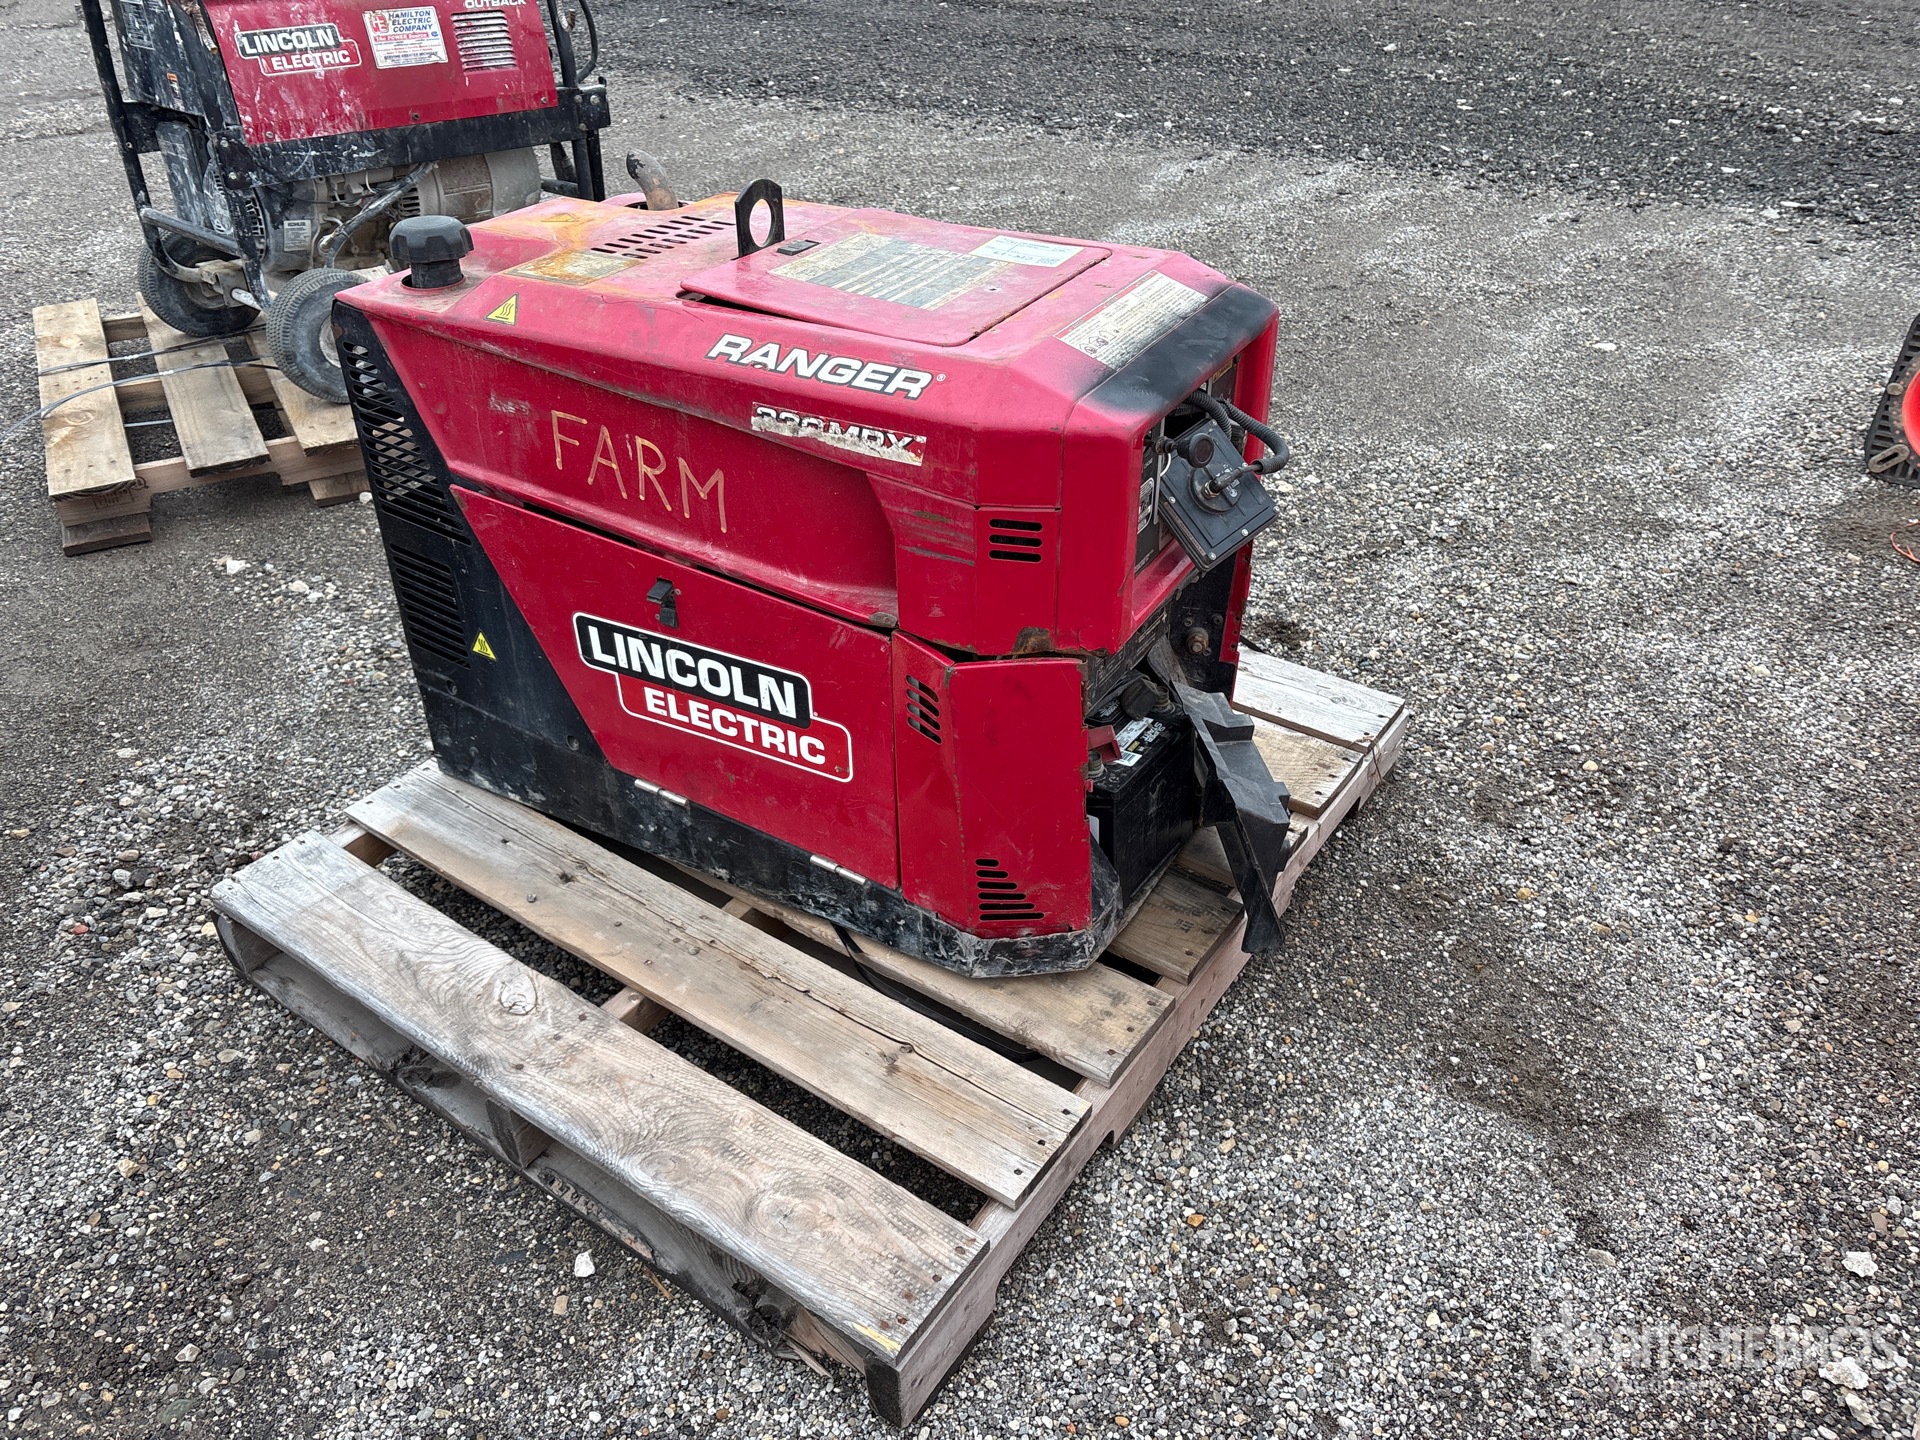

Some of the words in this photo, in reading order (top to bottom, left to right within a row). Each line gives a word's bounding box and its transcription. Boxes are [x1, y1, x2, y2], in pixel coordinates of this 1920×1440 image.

[388, 10, 431, 19] HAMILTON
[465, 0, 526, 8] OUTBACK
[392, 17, 432, 26] ELECTRIC
[393, 24, 433, 33] COMPANY
[241, 28, 336, 54] LINCOLN
[270, 49, 351, 71] ELECTRIC
[707, 333, 932, 399] RANGER
[551, 409, 728, 534] FARM
[587, 625, 797, 719] LINCOLN
[643, 686, 826, 765] ELECTRIC
